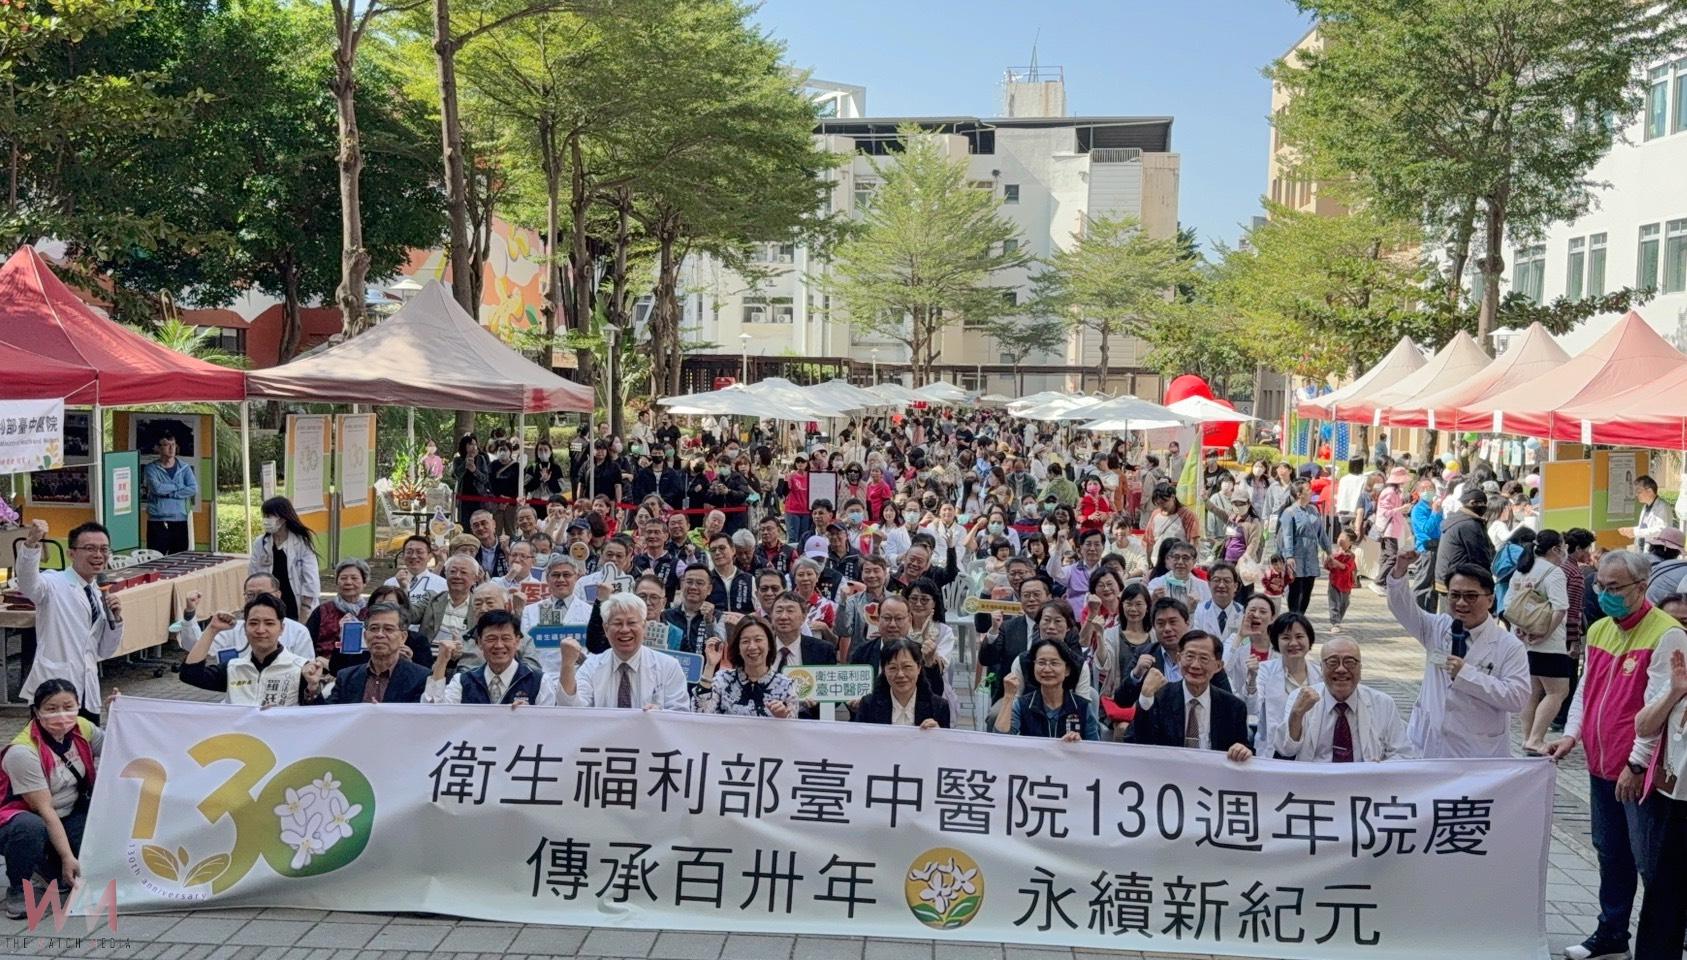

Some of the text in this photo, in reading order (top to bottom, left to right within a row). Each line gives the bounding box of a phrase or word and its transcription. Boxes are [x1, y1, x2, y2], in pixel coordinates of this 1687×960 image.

[816, 670, 870, 682] 衛生福利部
[816, 683, 870, 697] 臺中醫院
[119, 732, 376, 896] 130
[428, 740, 1495, 858] 衛生福利部臺中醫院130週年院慶
[127, 843, 207, 900] 130th anniversary
[526, 836, 1381, 946] 傳承百卅年 永續新紀元
